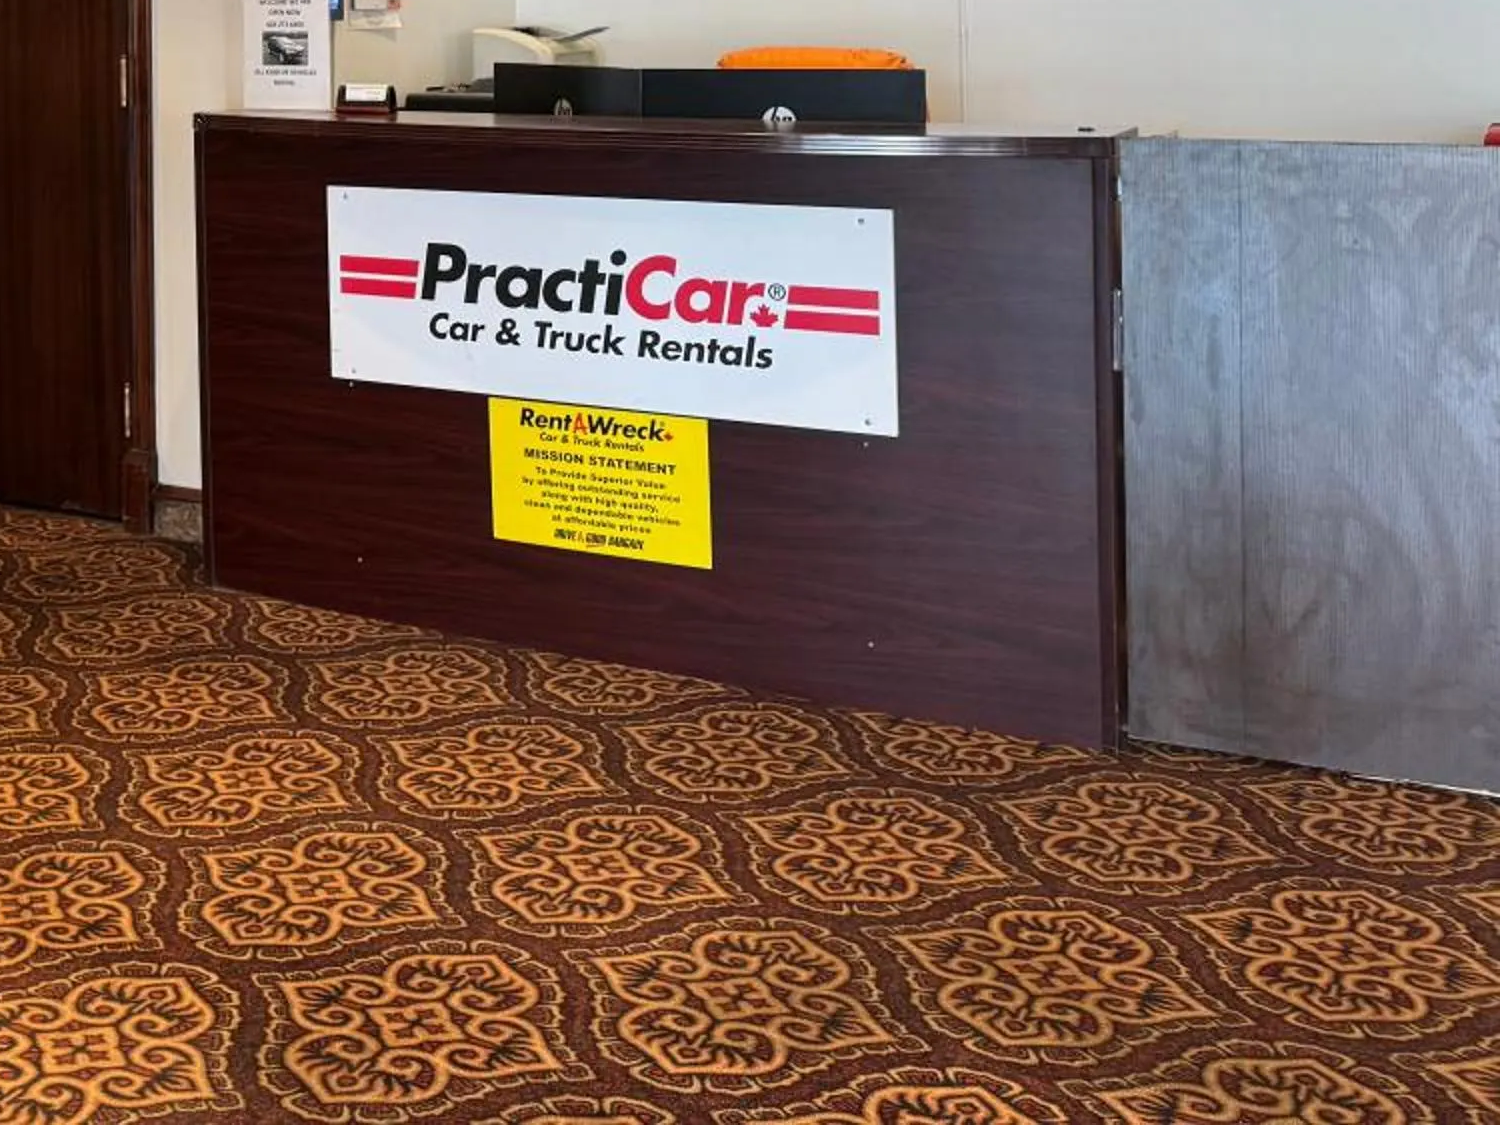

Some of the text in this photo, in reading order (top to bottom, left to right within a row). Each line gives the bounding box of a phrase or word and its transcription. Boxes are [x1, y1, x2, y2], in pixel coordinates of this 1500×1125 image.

[421, 242, 766, 325] PractiCar
[429, 312, 773, 369] Car & Truck Rentals
[539, 432, 644, 452] Car & Truck Rentals
[524, 447, 676, 475] MISSION STATEMENT
[536, 466, 666, 489] To Provide Superior Value
[537, 478, 575, 491] offering
[577, 483, 639, 499] outstanding
[541, 490, 568, 501] along
[572, 493, 592, 504] with
[595, 496, 617, 509] high
[524, 499, 680, 526] clean and dependable vehicles
[565, 516, 616, 530] affordable
